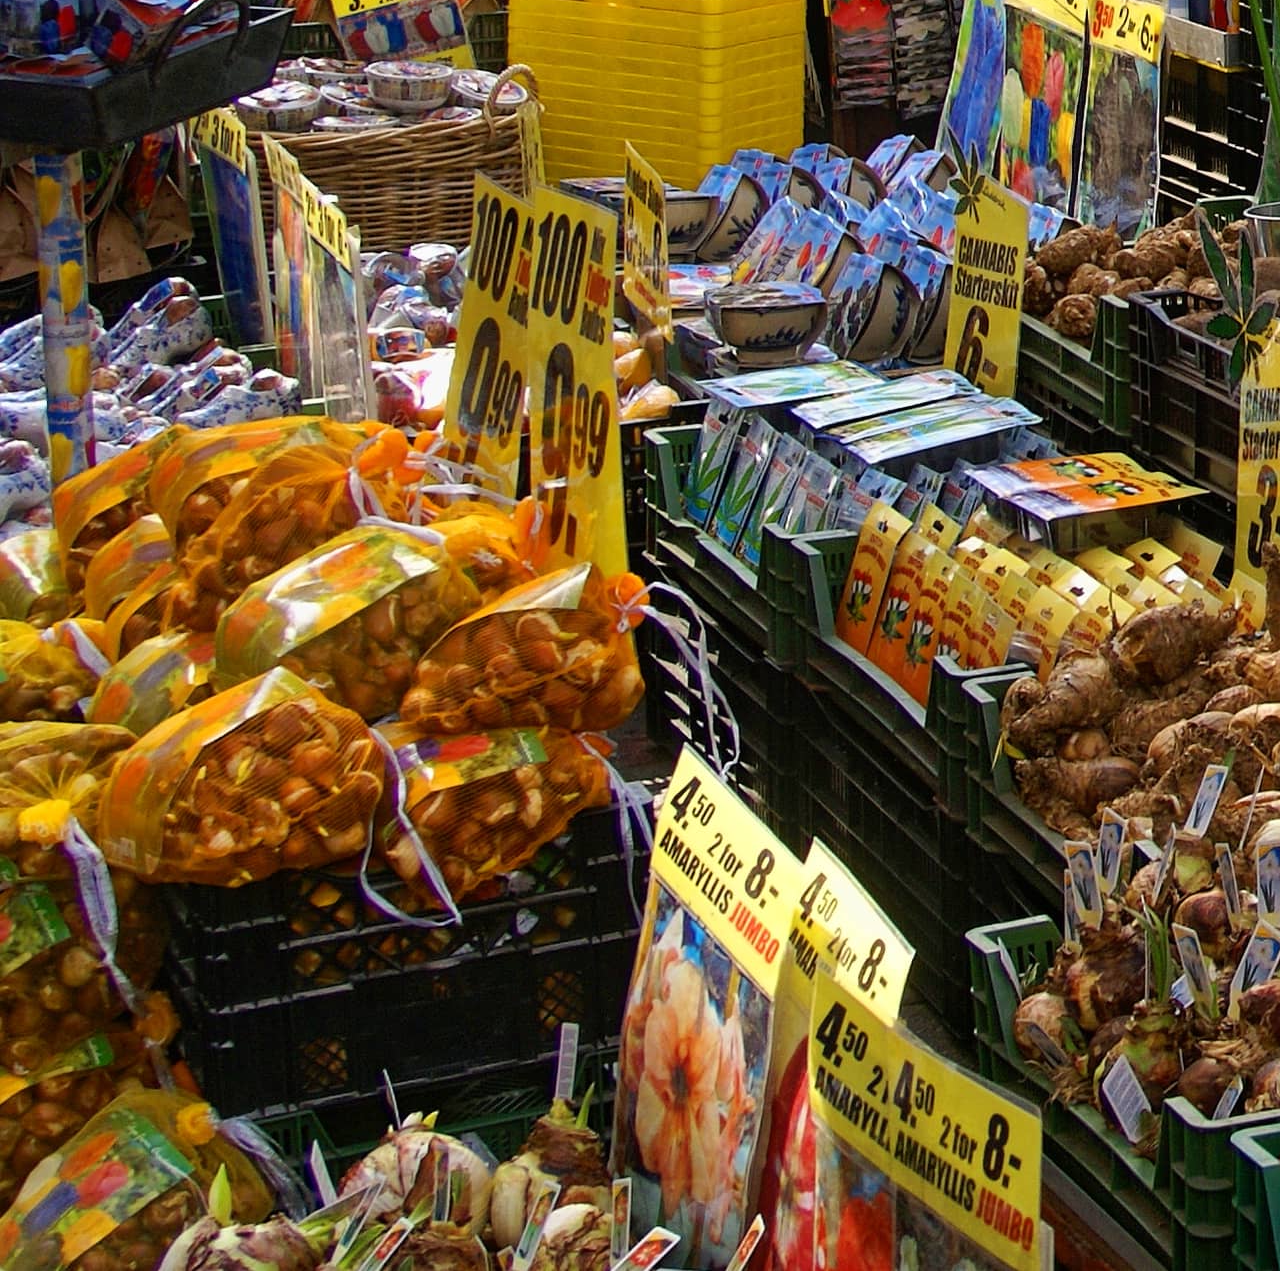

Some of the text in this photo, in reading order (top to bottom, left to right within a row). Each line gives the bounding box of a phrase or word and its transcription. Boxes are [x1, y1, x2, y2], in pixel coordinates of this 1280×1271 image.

[1092, 0, 1129, 40] 3.50 2
[468, 192, 520, 303] 100
[531, 211, 589, 326] 100
[954, 265, 1020, 309] Starterskit
[958, 234, 1020, 278] CANNABIS
[657, 825, 781, 965] AMARYLLIS JUMBO
[669, 775, 781, 910] 4.50 for 8.-
[799, 872, 837, 929] 4.50
[815, 1001, 870, 1069] 4.50
[893, 1060, 1023, 1191] 4.50 for 8.-
[894, 1128, 1035, 1253] AMARYLLIS JUMBO
